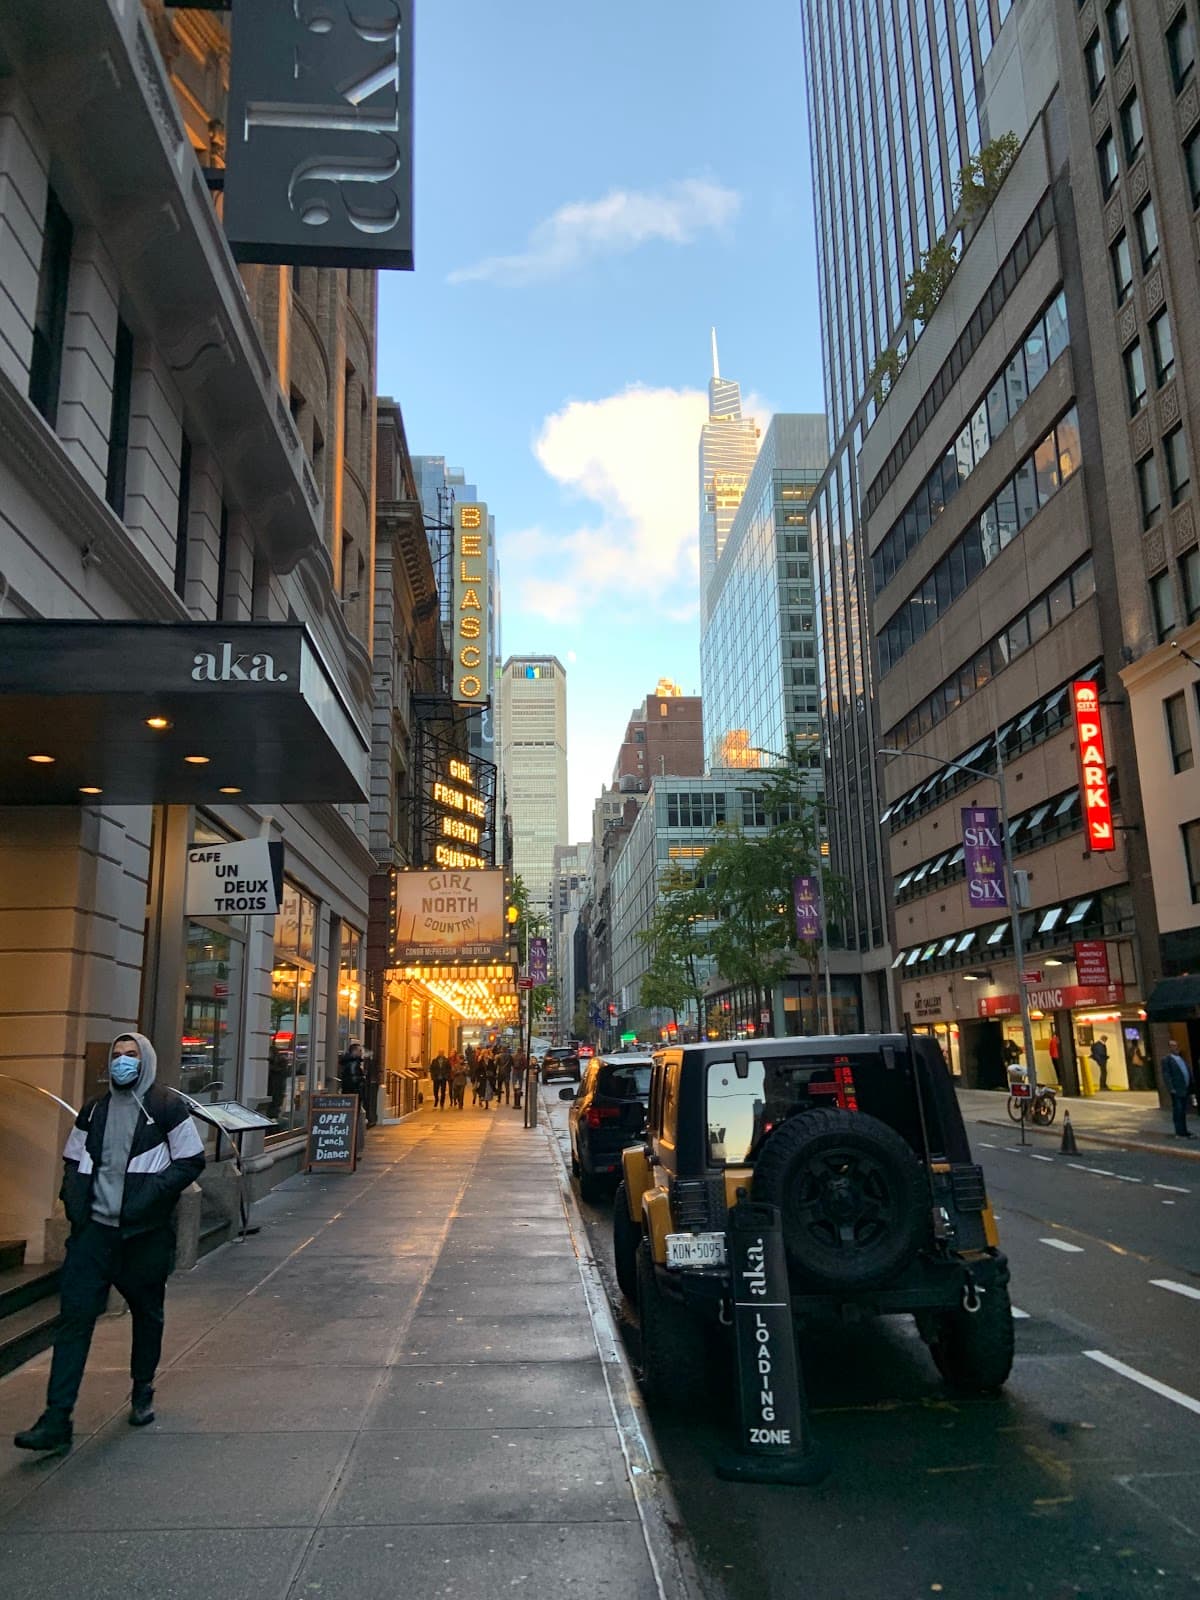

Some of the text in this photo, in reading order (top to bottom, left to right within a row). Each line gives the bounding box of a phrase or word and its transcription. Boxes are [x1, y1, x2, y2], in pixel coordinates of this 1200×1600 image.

[460, 507, 482, 697] BELASCO
[191, 642, 288, 682] aka.
[1076, 701, 1097, 709] CITY
[449, 759, 473, 784] GIRL
[1081, 723, 1107, 808] PARK
[434, 782, 486, 818] FROM THE
[443, 817, 478, 844] NORTH
[189, 852, 221, 863] CAFE
[436, 845, 486, 868] COUNTRY
[215, 864, 239, 878] UN
[224, 880, 268, 894] DEUX
[428, 874, 473, 892] GIRL
[214, 897, 266, 912] TROIS
[422, 897, 478, 913] NORTH
[424, 915, 476, 934] COUNTRY
[1027, 990, 1062, 1010] ARKING
[319, 1113, 347, 1124] OPEN
[312, 1125, 349, 1136] Breakfast
[318, 1137, 344, 1147] Lunch
[316, 1148, 350, 1160] Dinner
[755, 1313, 775, 1421] LOADING
[749, 1428, 791, 1444] ZONE
